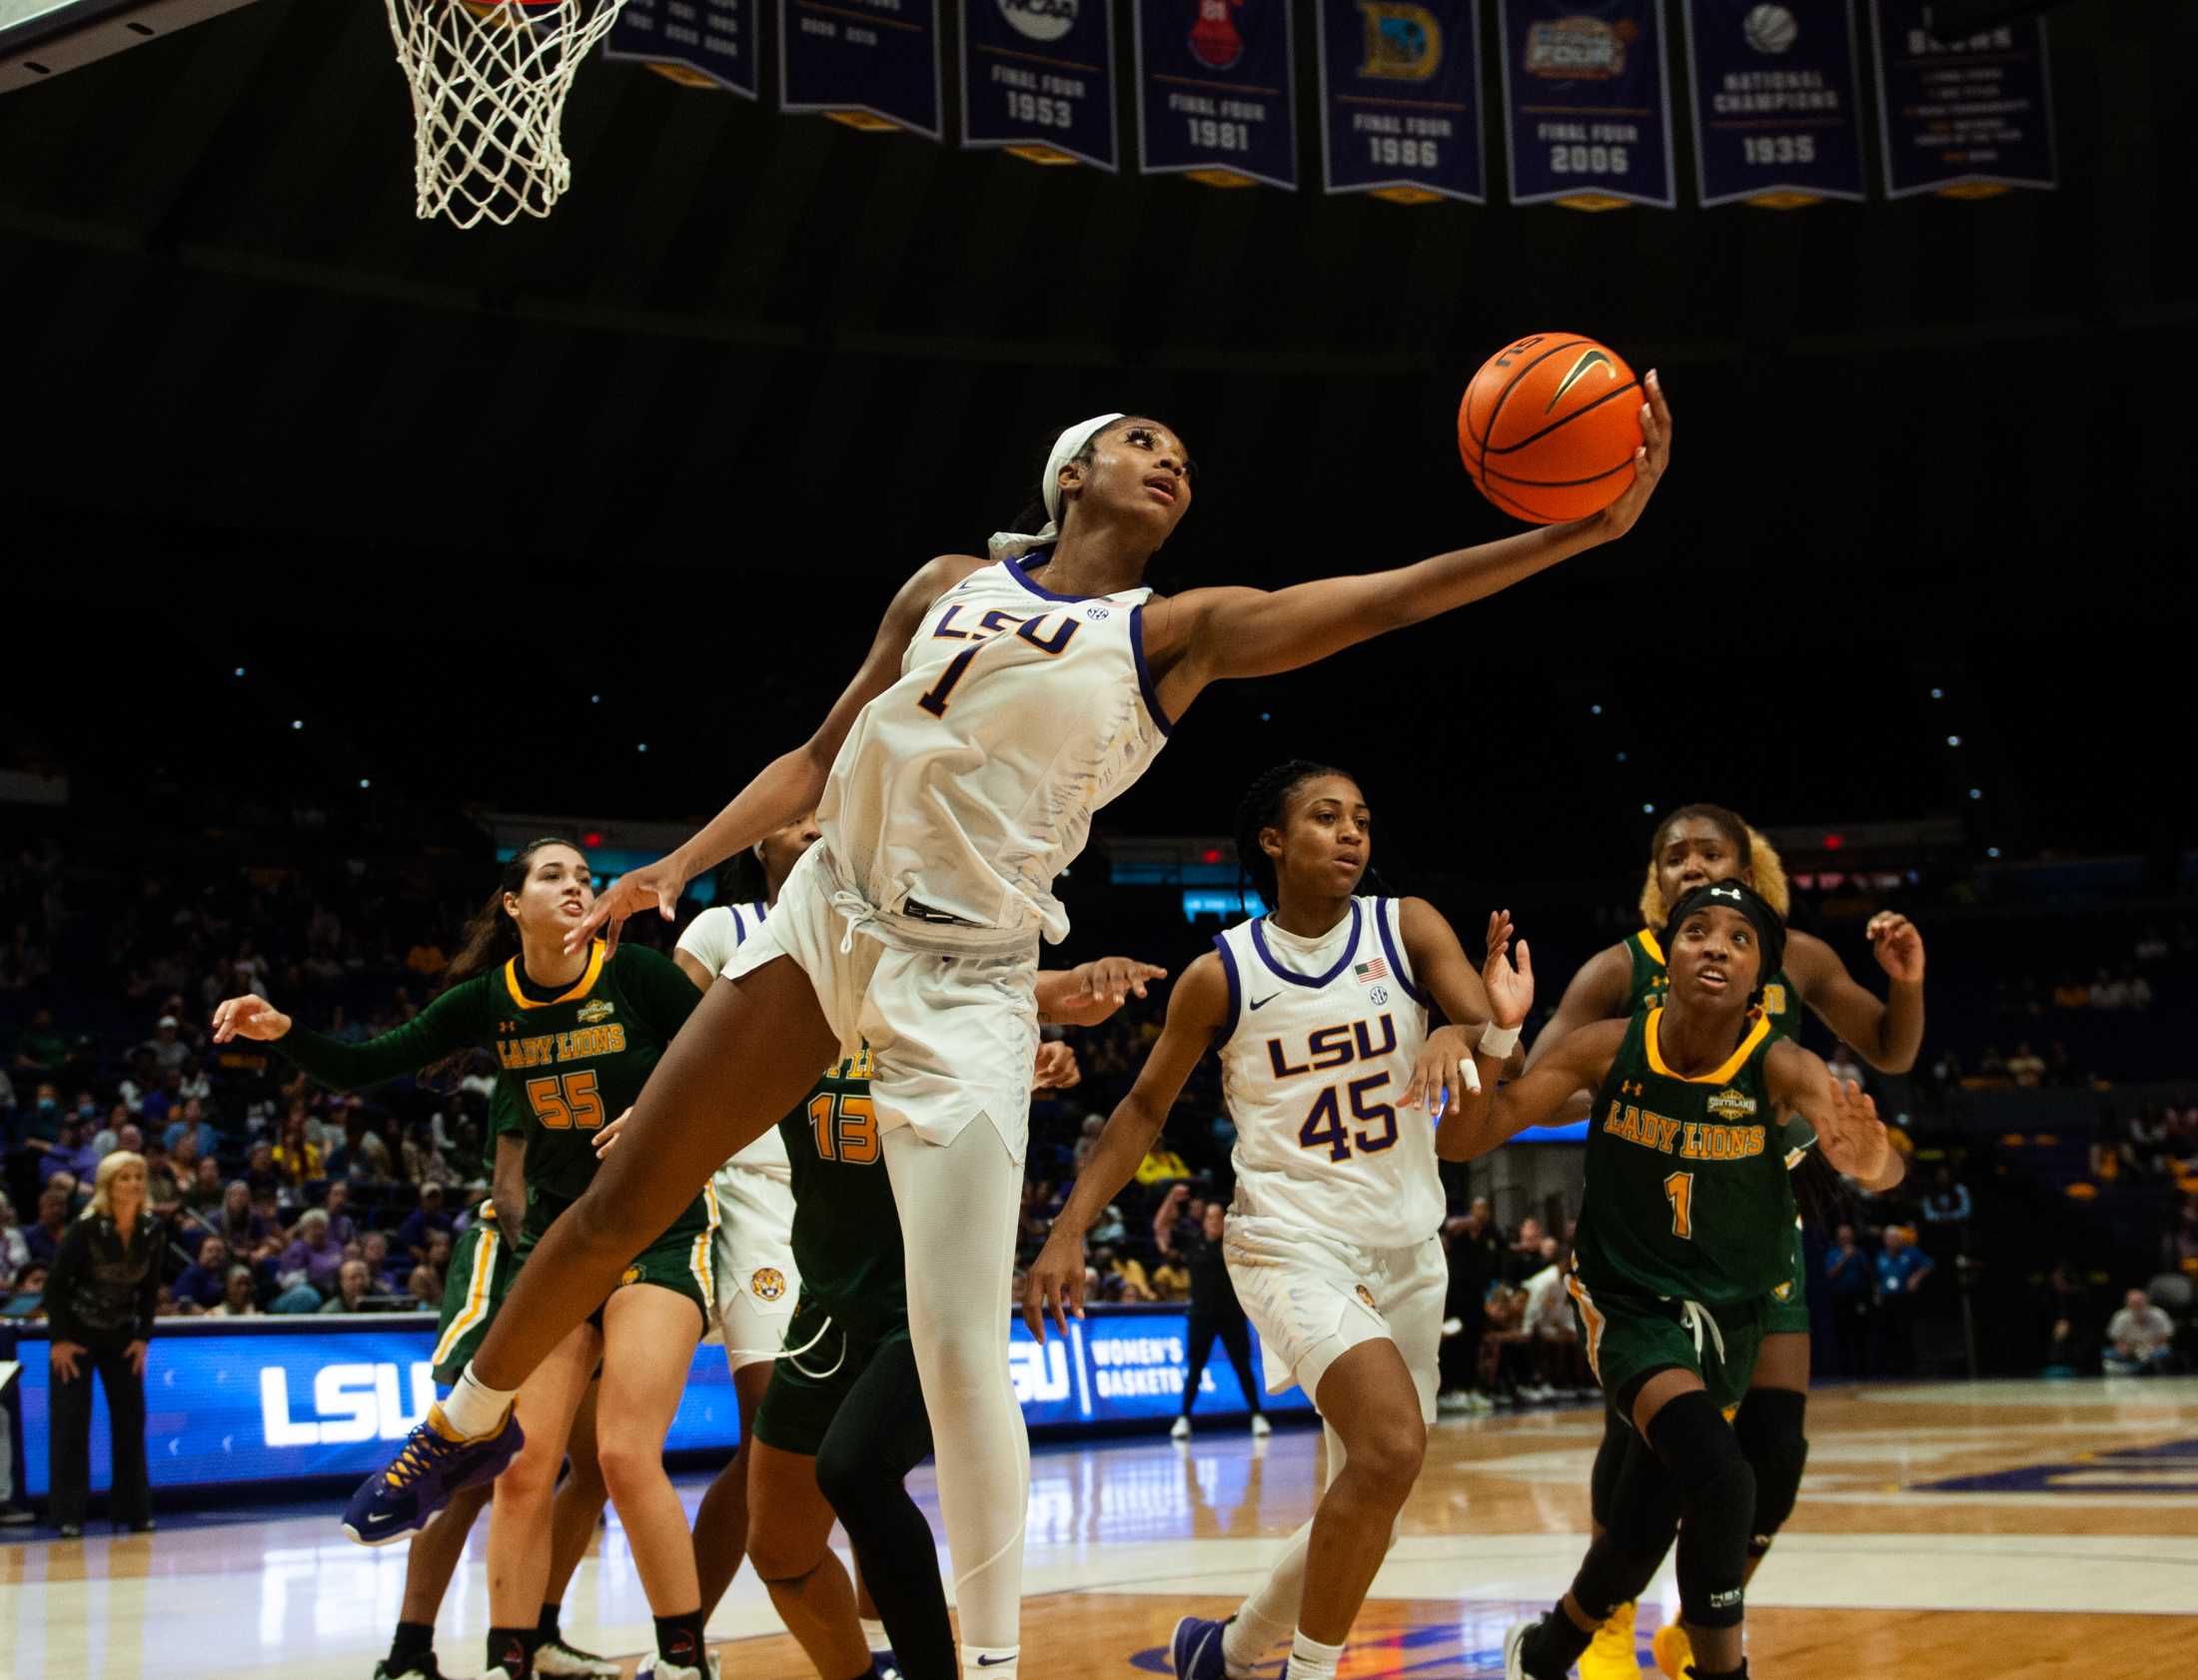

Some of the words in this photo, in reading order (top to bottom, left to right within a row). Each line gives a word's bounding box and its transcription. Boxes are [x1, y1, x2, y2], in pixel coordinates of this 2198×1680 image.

[991, 64, 1037, 91] FINAL
[1040, 75, 1086, 98] FOUR
[1724, 70, 1822, 91] NATIONAL
[1007, 90, 1073, 128] 1953
[1169, 94, 1216, 116] FINAL
[1219, 101, 1265, 121] FOUR
[1712, 90, 1838, 113] CHAMPIONS
[1187, 118, 1248, 151] 1981
[1353, 113, 1402, 133] FINAL
[1406, 117, 1453, 137] FOUR
[1537, 122, 1588, 142] FINAL
[1591, 124, 1639, 143] FOUR
[1369, 137, 1439, 168] 1986
[1550, 145, 1631, 175] 2006
[1743, 135, 1816, 165] 1935
[932, 604, 1083, 656] LSU
[916, 642, 984, 720] 1
[497, 1035, 553, 1069] LADY
[556, 1023, 626, 1063] LIONS
[1266, 1013, 1398, 1081] LSU
[526, 1069, 605, 1130] 55
[1299, 1070, 1399, 1165] 45
[807, 1092, 881, 1165] 13
[1604, 1099, 1680, 1154] LADY
[1679, 1122, 1766, 1161] LIONS
[1662, 1171, 1694, 1240] 1
[1090, 1337, 1184, 1366] WOMEN'S
[1008, 1340, 1070, 1403] SU
[1096, 1366, 1216, 1398] BASKETBL
[260, 1361, 438, 1447] LSU
